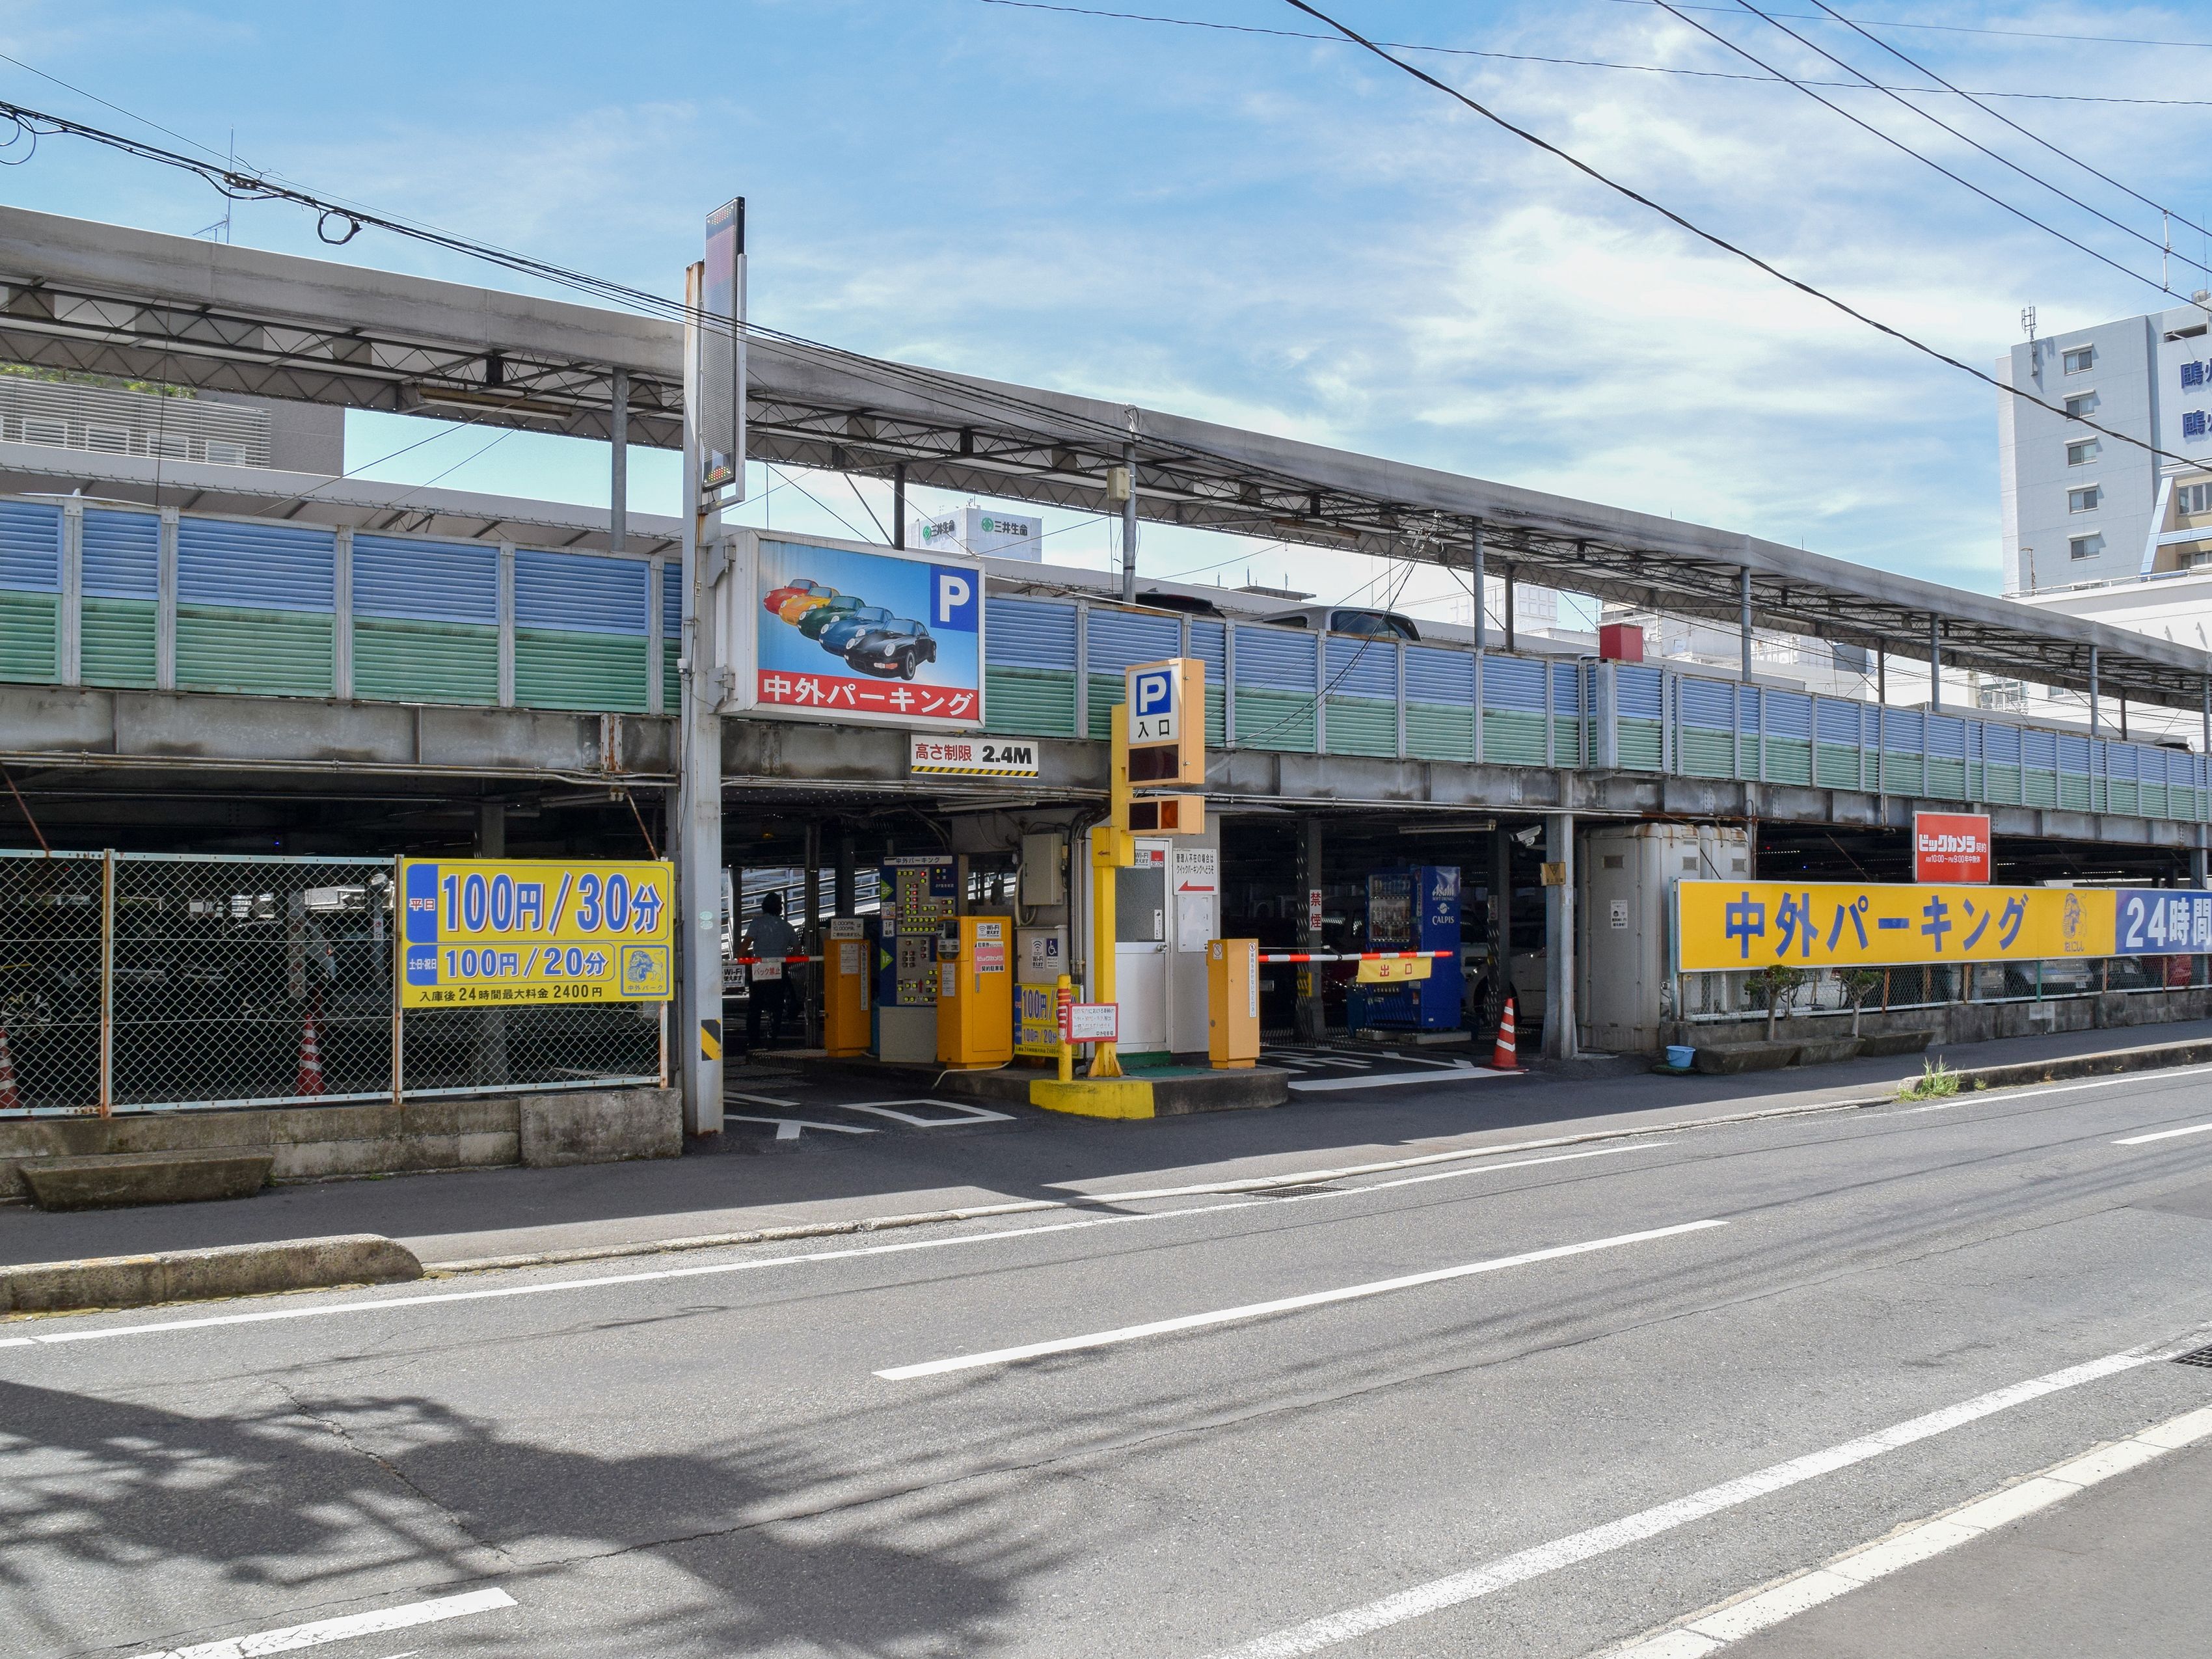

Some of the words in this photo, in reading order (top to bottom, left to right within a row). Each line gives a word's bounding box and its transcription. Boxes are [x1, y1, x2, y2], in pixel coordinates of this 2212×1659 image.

[2180, 358, 2212, 388] 鷗
[2182, 407, 2212, 437] 鷗
[931, 520, 954, 537] 三井生命
[994, 521, 1028, 536] 三井生命
[939, 575, 970, 622] P
[763, 675, 974, 716] 中外パーキング
[1140, 676, 1167, 712] P
[1138, 719, 1170, 738] 入口
[915, 744, 972, 762] 高さ制限
[981, 745, 1032, 764] 2.4M
[1919, 834, 1975, 852] ビックカメラ
[1976, 843, 1987, 852] 契約
[1432, 883, 1454, 897] Asahi
[409, 898, 435, 911] 平日
[442, 870, 665, 936] 100円/30分
[1310, 891, 1322, 928] 禁煙
[1432, 915, 1455, 925] CALPIS
[1725, 891, 2029, 958] 中外パーキング
[2125, 897, 2212, 947] 24時間
[445, 946, 608, 979] 100円/20分
[753, 967, 781, 976] バック禁止
[1379, 963, 1412, 977] 出口
[628, 984, 662, 992] 中外パーク
